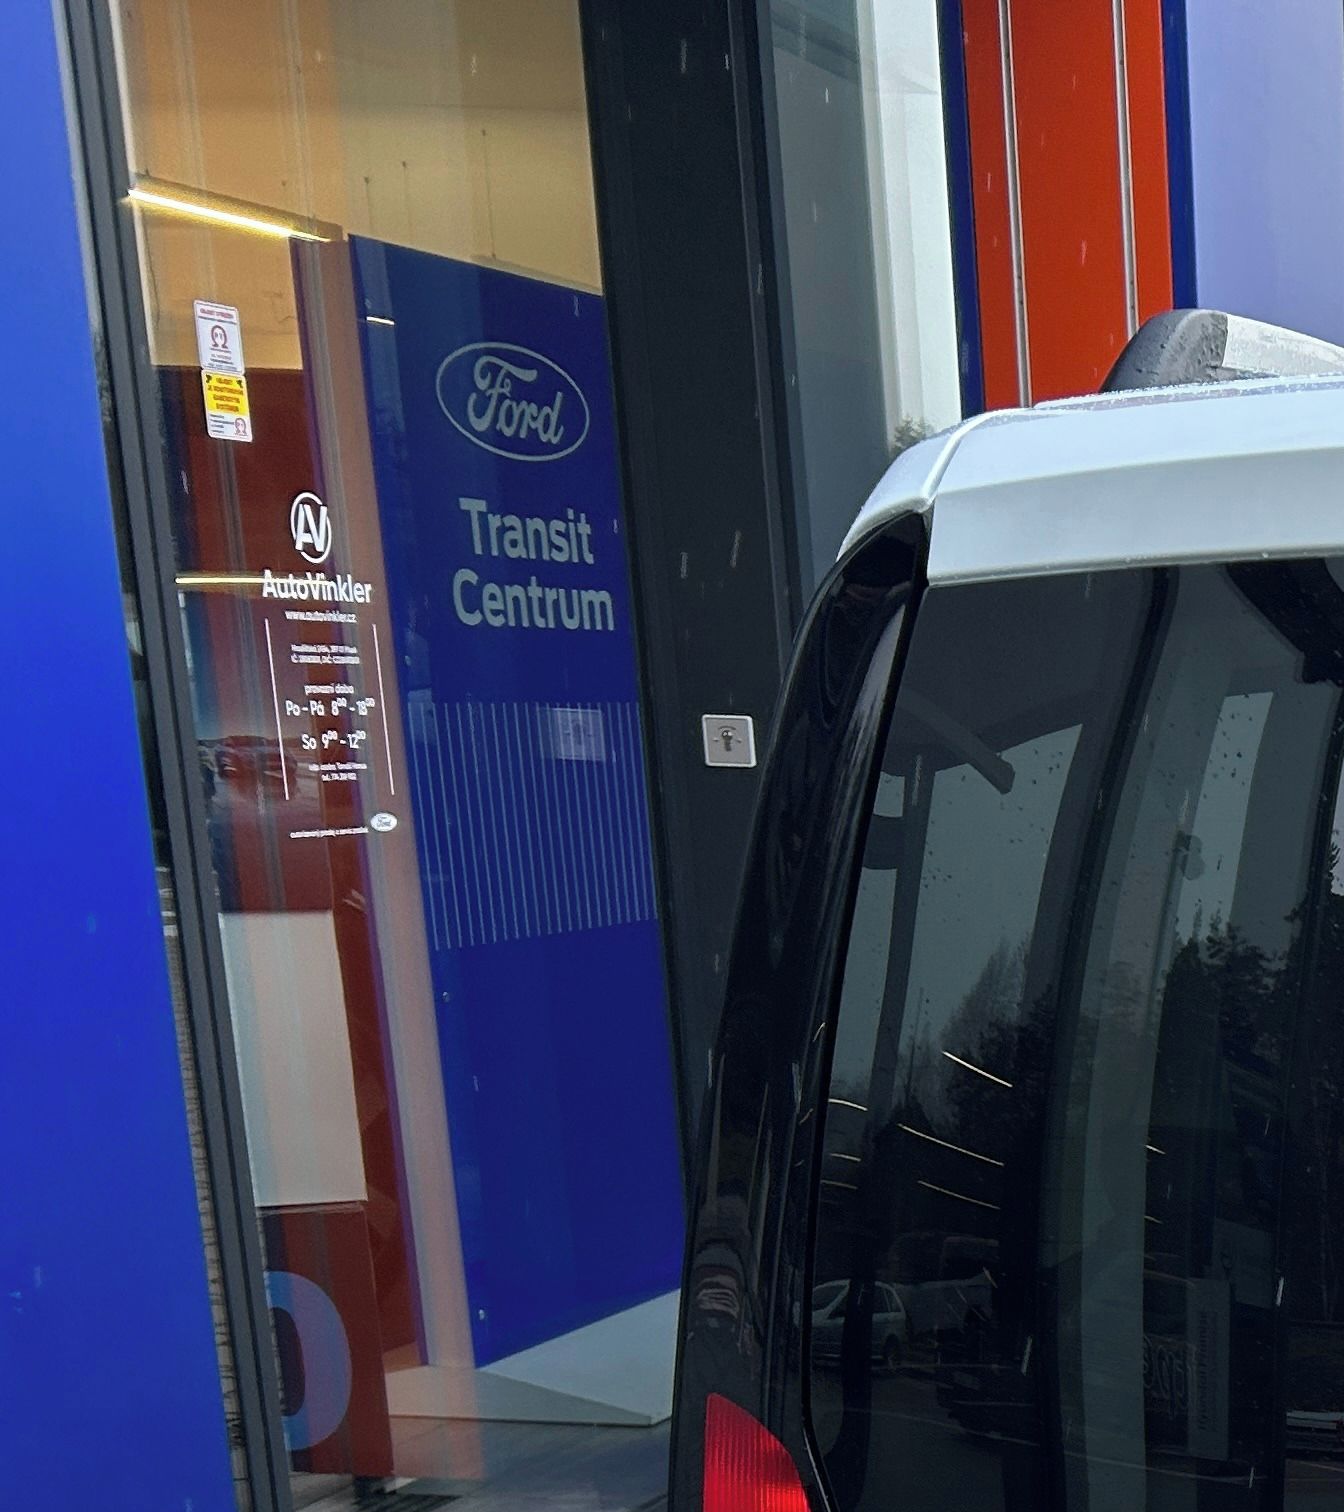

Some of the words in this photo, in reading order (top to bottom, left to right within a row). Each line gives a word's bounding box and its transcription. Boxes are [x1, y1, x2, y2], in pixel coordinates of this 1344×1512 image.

[467, 355, 565, 444] Ford
[459, 497, 594, 564] Transit
[262, 569, 373, 603] AutoVinkler
[453, 568, 615, 631] Centrum
